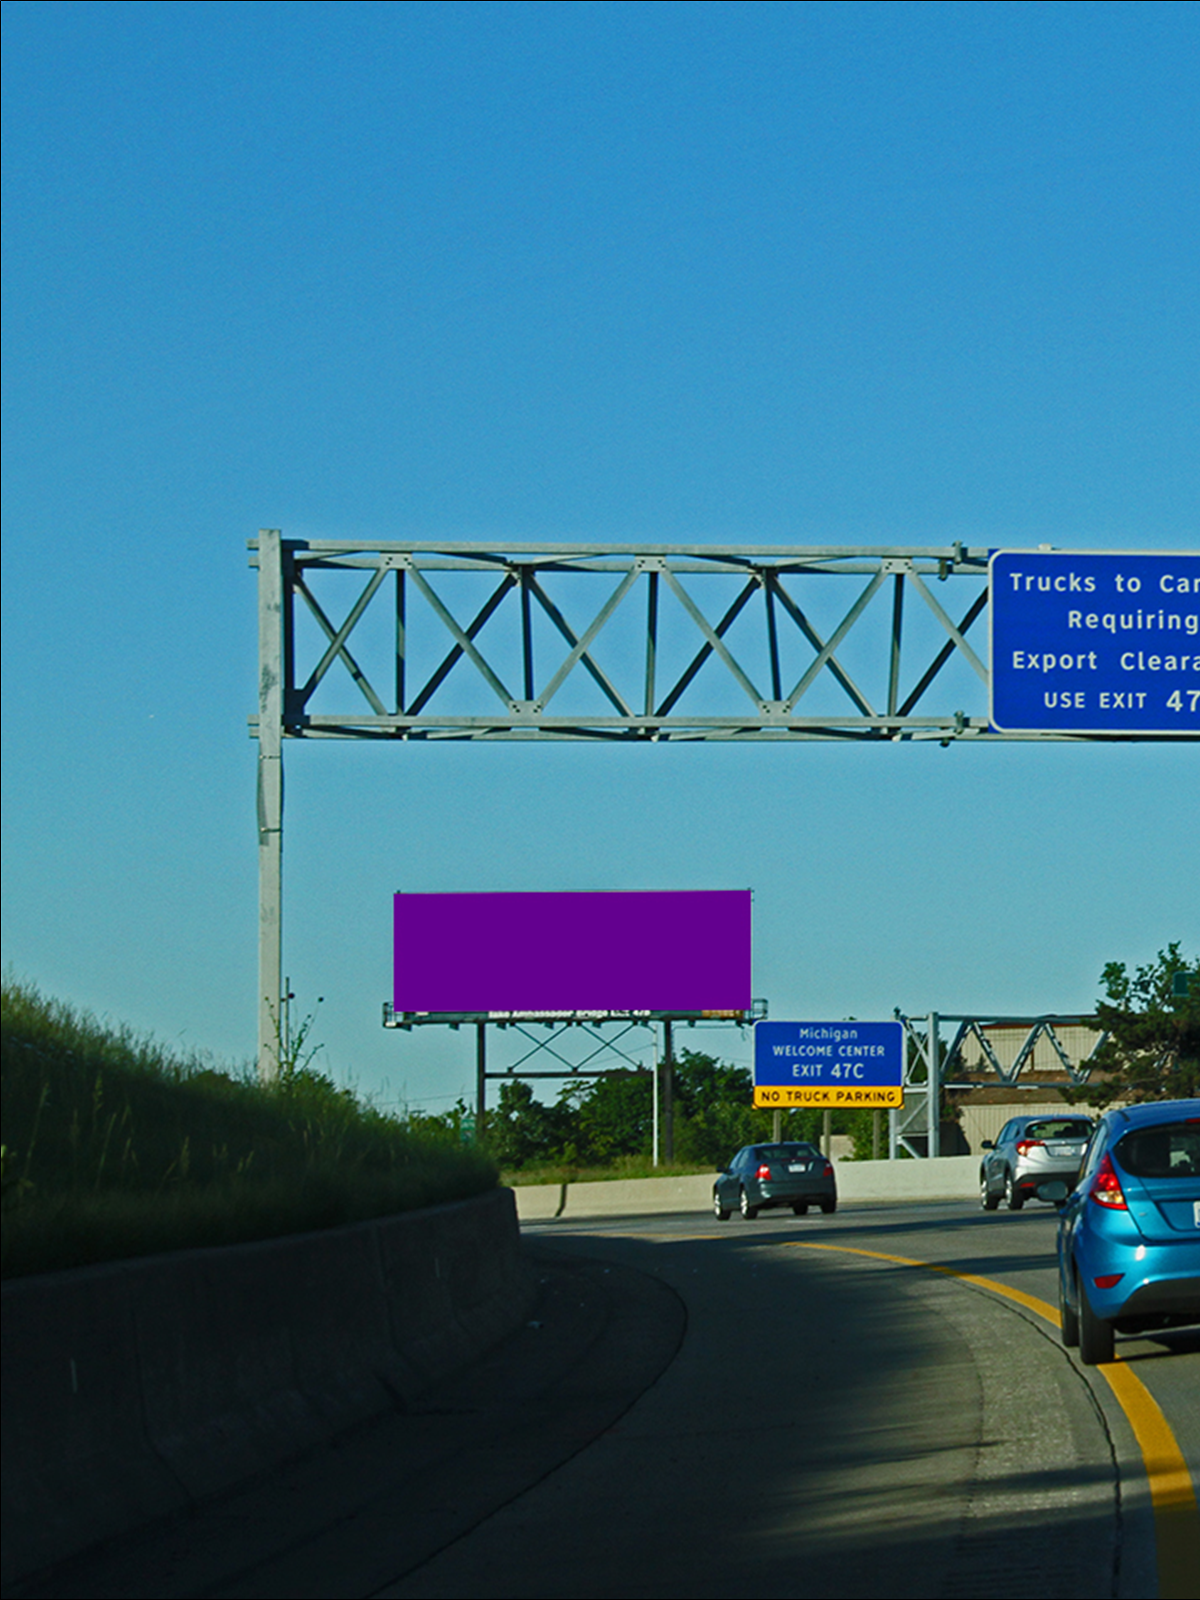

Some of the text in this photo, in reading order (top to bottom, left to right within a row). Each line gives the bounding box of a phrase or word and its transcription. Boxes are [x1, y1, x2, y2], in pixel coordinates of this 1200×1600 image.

[1009, 572, 1096, 592] Trucks
[1114, 574, 1141, 593] to
[1068, 609, 1198, 635] Requiring
[1012, 650, 1097, 673] Export
[1044, 691, 1085, 709] USE
[1099, 692, 1147, 709] EXIT
[799, 1027, 858, 1042] Michigan
[772, 1045, 885, 1057] WELCOME CENTER
[792, 1063, 864, 1079] EXIT 47C
[761, 1091, 895, 1102] NO TRUCK PARKING
